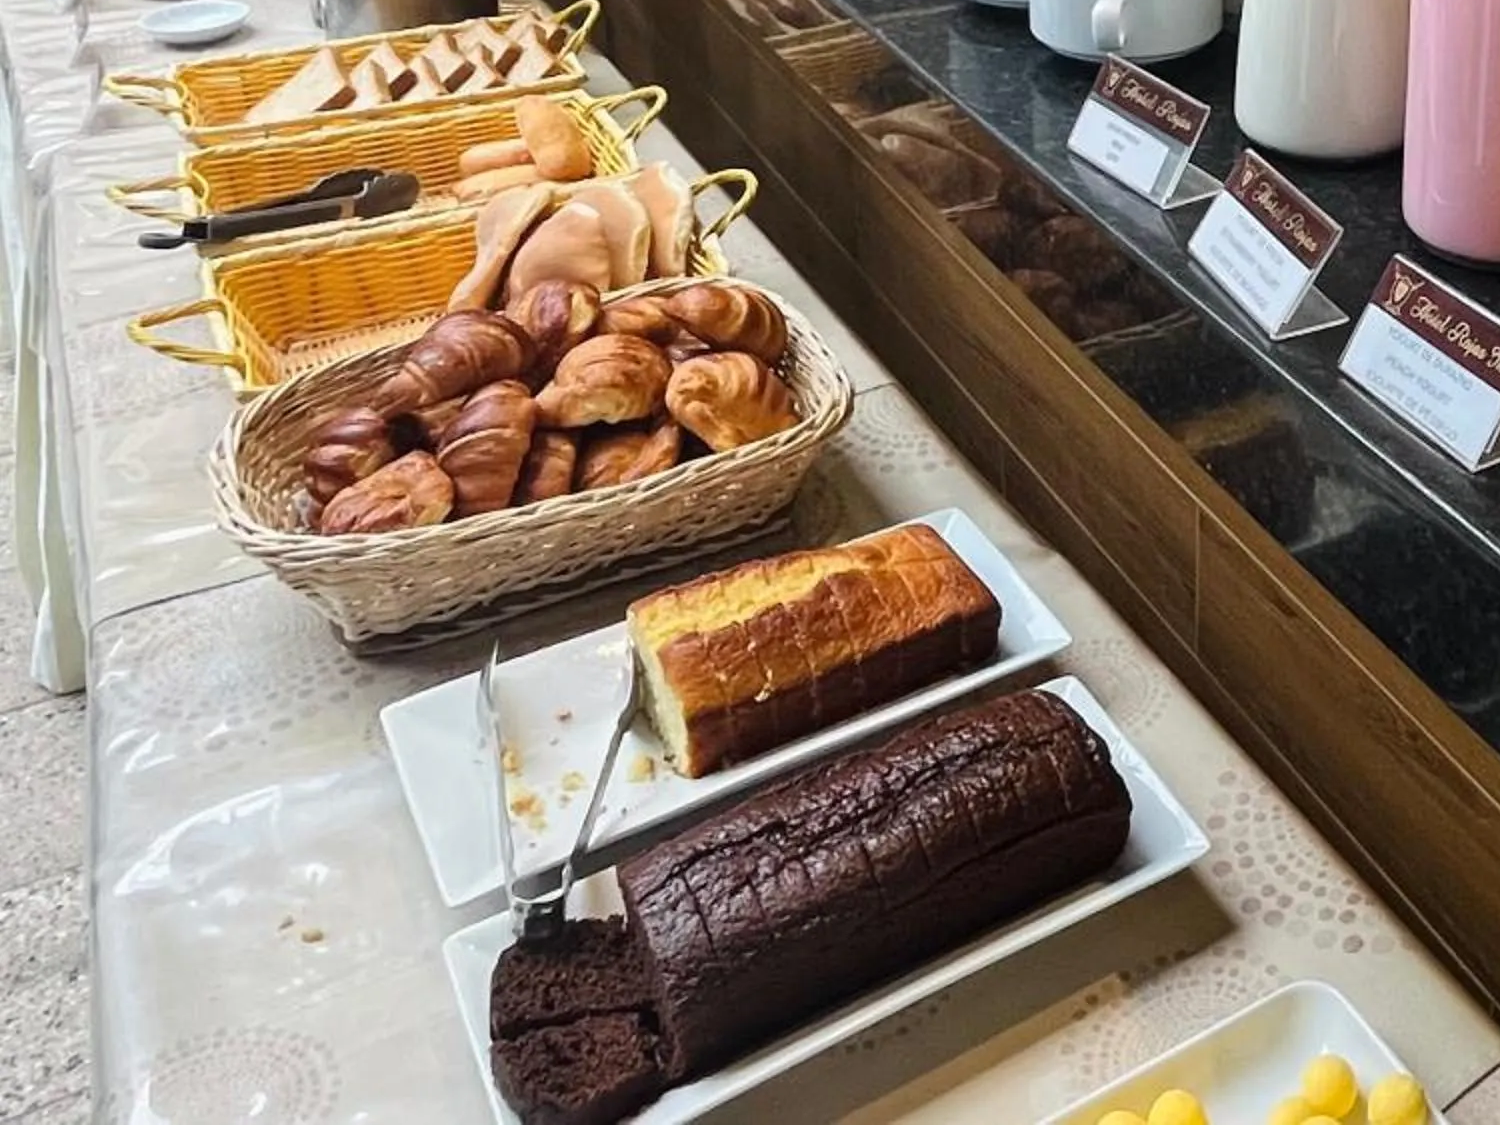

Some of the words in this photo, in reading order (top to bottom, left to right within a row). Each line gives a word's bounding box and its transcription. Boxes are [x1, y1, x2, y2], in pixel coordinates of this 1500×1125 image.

[1121, 78, 1158, 110] Hotel
[1155, 100, 1191, 131] Rojas
[1252, 182, 1290, 221] Hotel
[1283, 213, 1318, 252] Rojas
[1410, 296, 1450, 333] Hotel
[1447, 323, 1488, 360] Rojas
